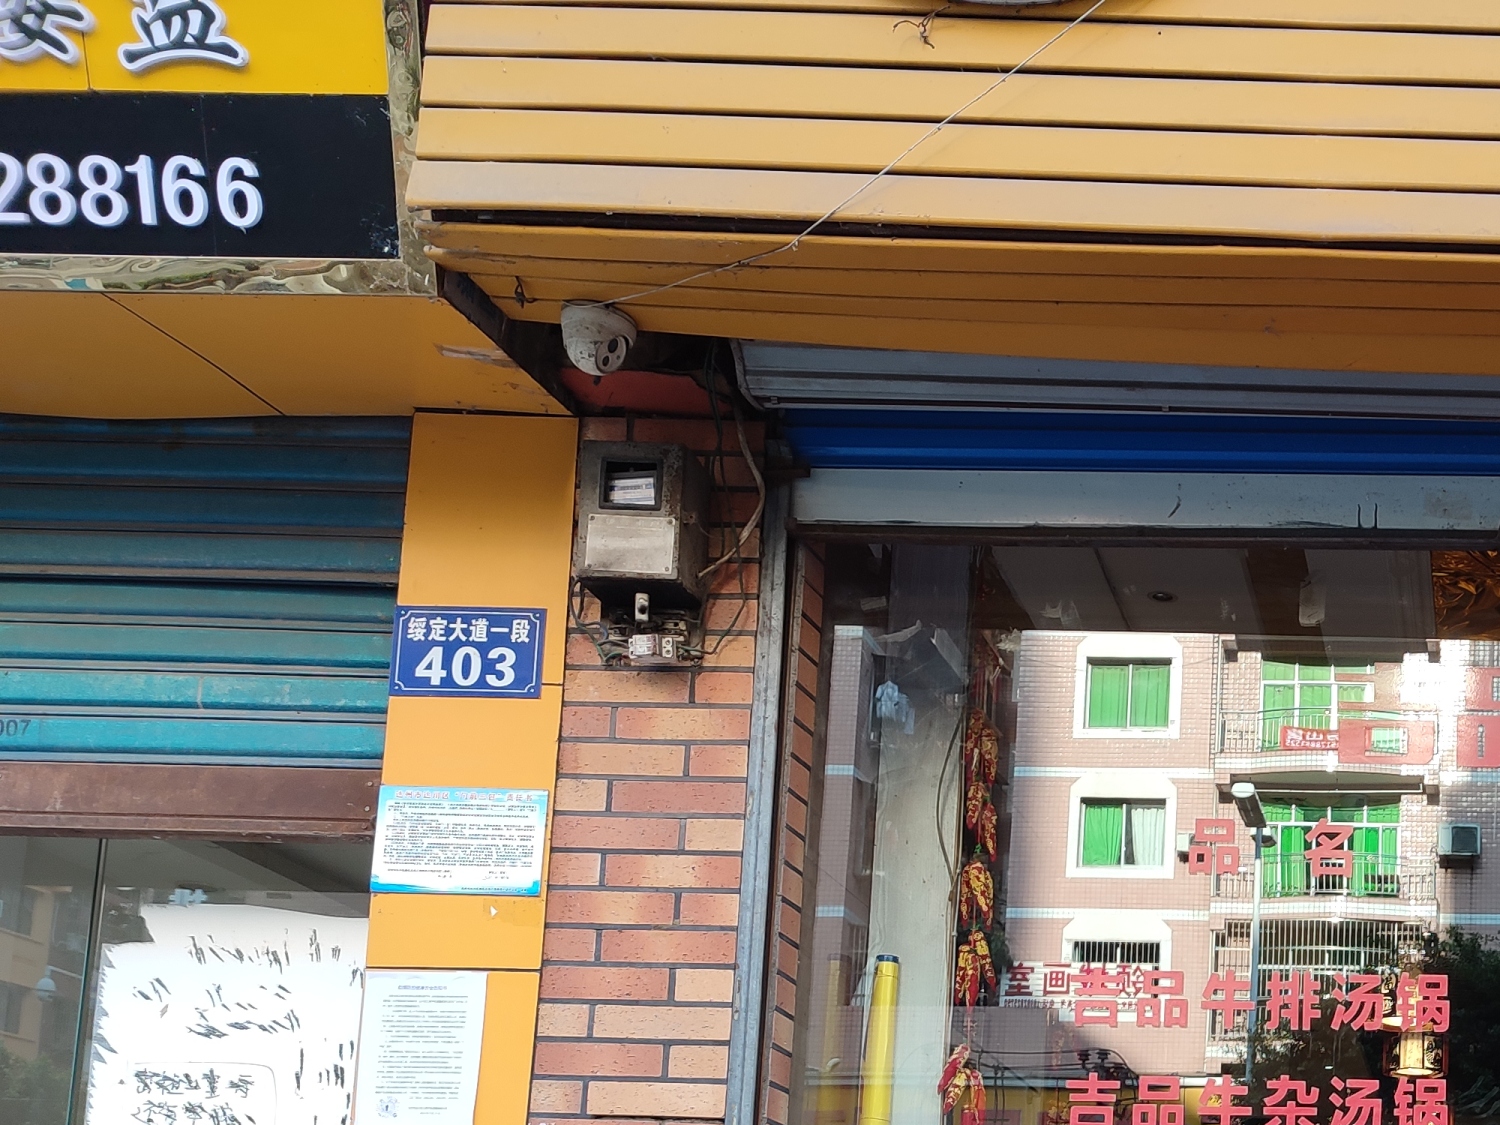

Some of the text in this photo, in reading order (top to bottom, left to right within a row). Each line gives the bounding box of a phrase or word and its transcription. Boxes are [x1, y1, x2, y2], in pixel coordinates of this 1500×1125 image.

[407, 616, 531, 643] 绥定大道一段
[414, 645, 517, 688] 403
[1188, 817, 1354, 878] 品名
[1069, 970, 1451, 1033] 吉品牛排汤锅
